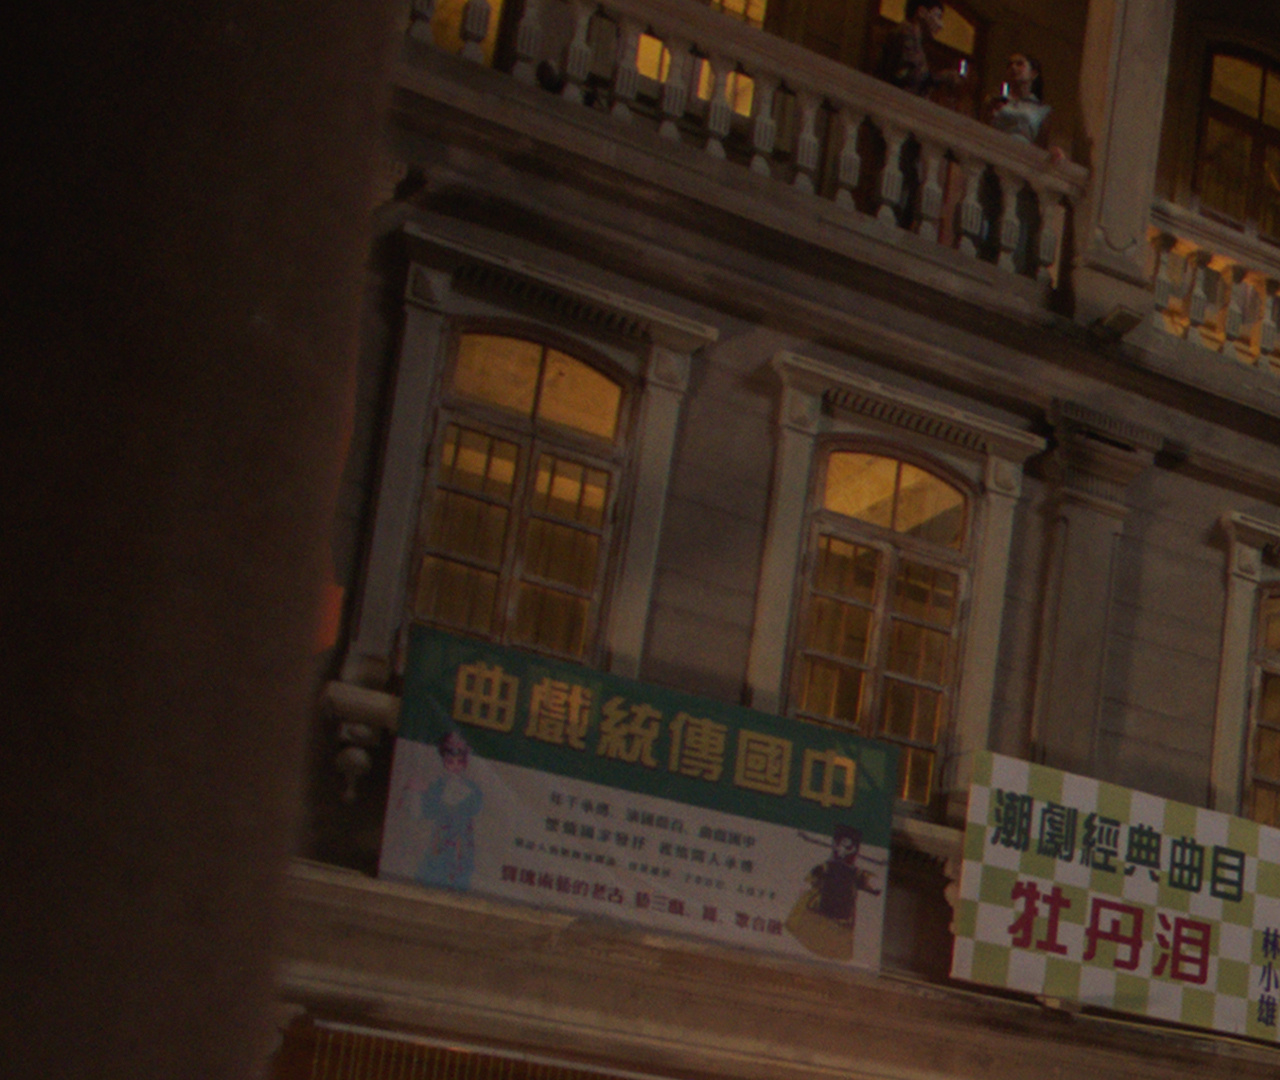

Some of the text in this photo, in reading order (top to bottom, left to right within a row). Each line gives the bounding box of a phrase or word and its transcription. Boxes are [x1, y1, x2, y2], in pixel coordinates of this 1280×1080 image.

[990, 788, 1247, 902] 潮劇經典曲目
[1007, 880, 1212, 986] 牡丹泪
